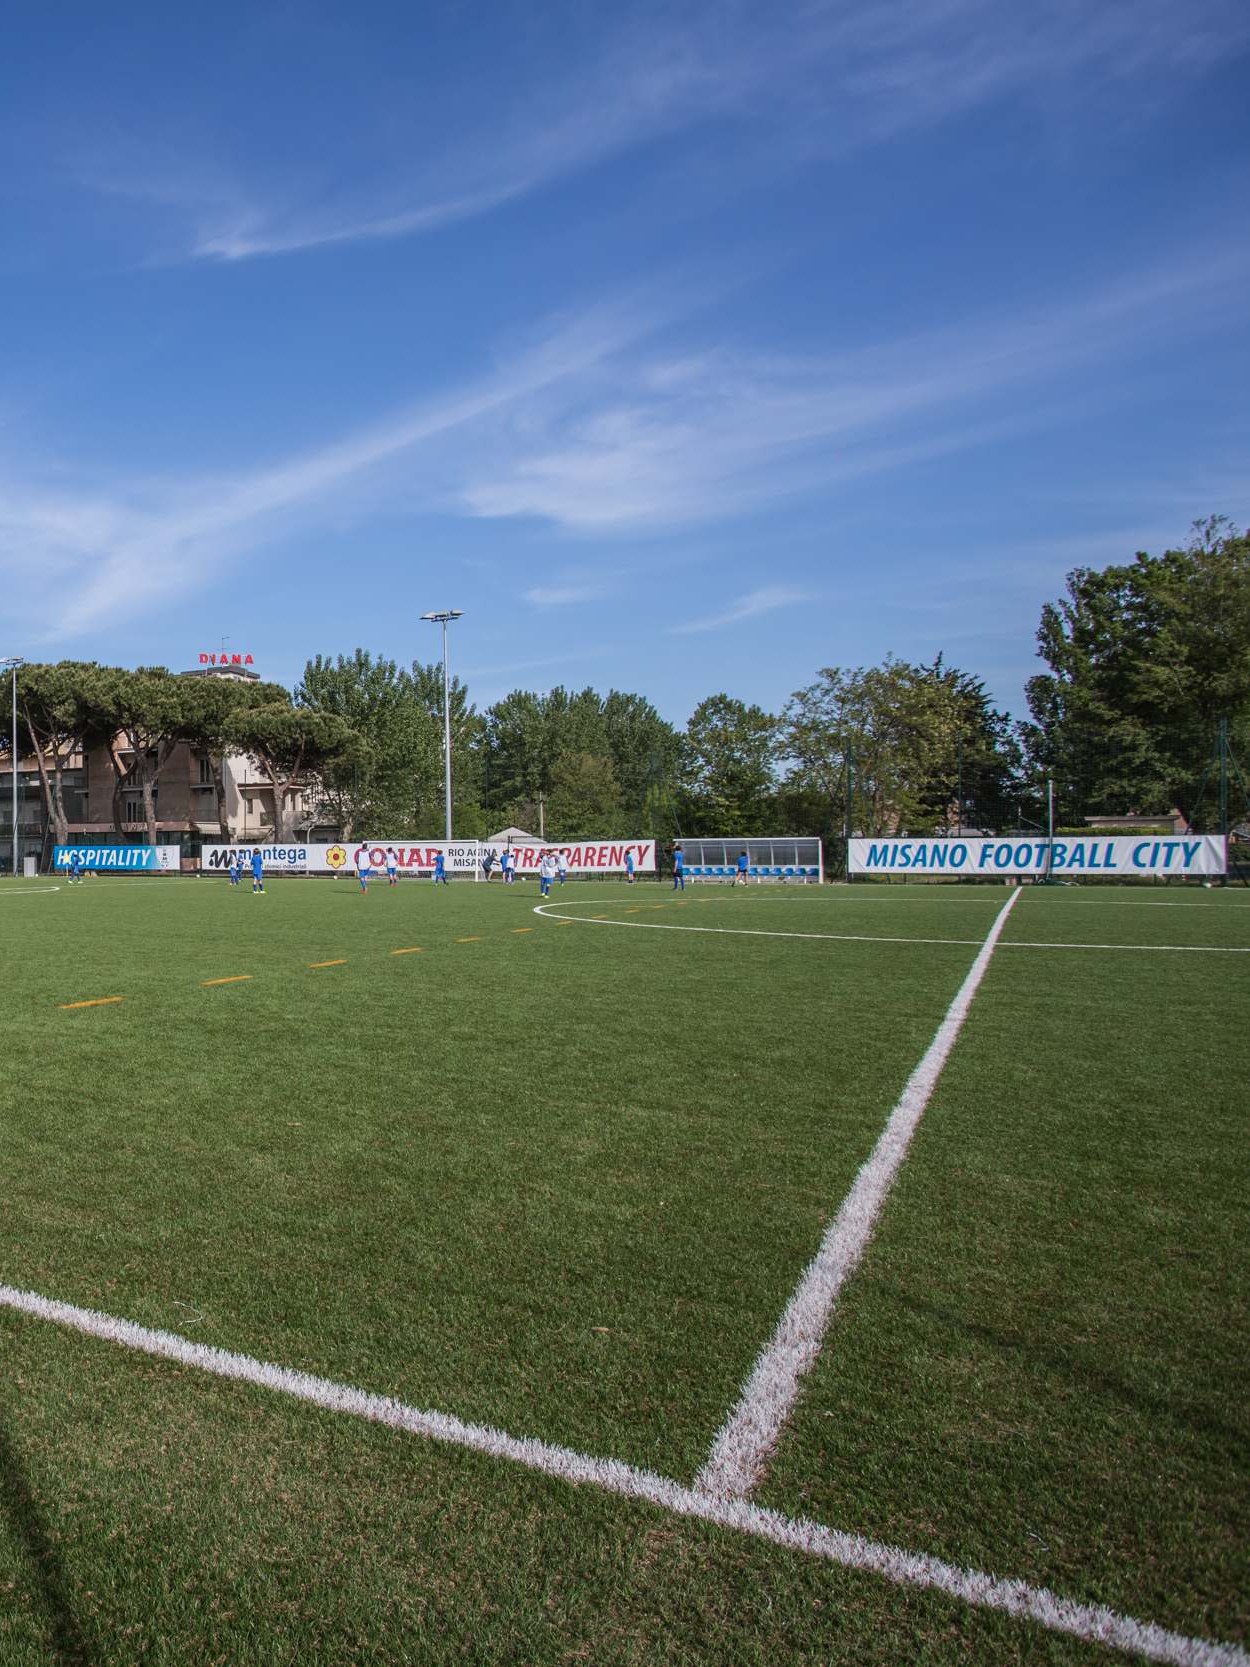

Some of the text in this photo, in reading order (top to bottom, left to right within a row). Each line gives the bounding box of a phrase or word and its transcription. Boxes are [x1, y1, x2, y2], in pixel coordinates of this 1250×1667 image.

[199, 653, 254, 664] DIANA
[239, 846, 306, 864] mntega
[448, 848, 464, 857] RIO
[865, 842, 1201, 868] MISANO FOOTBALL CITY
[453, 858, 490, 867] MISAN
